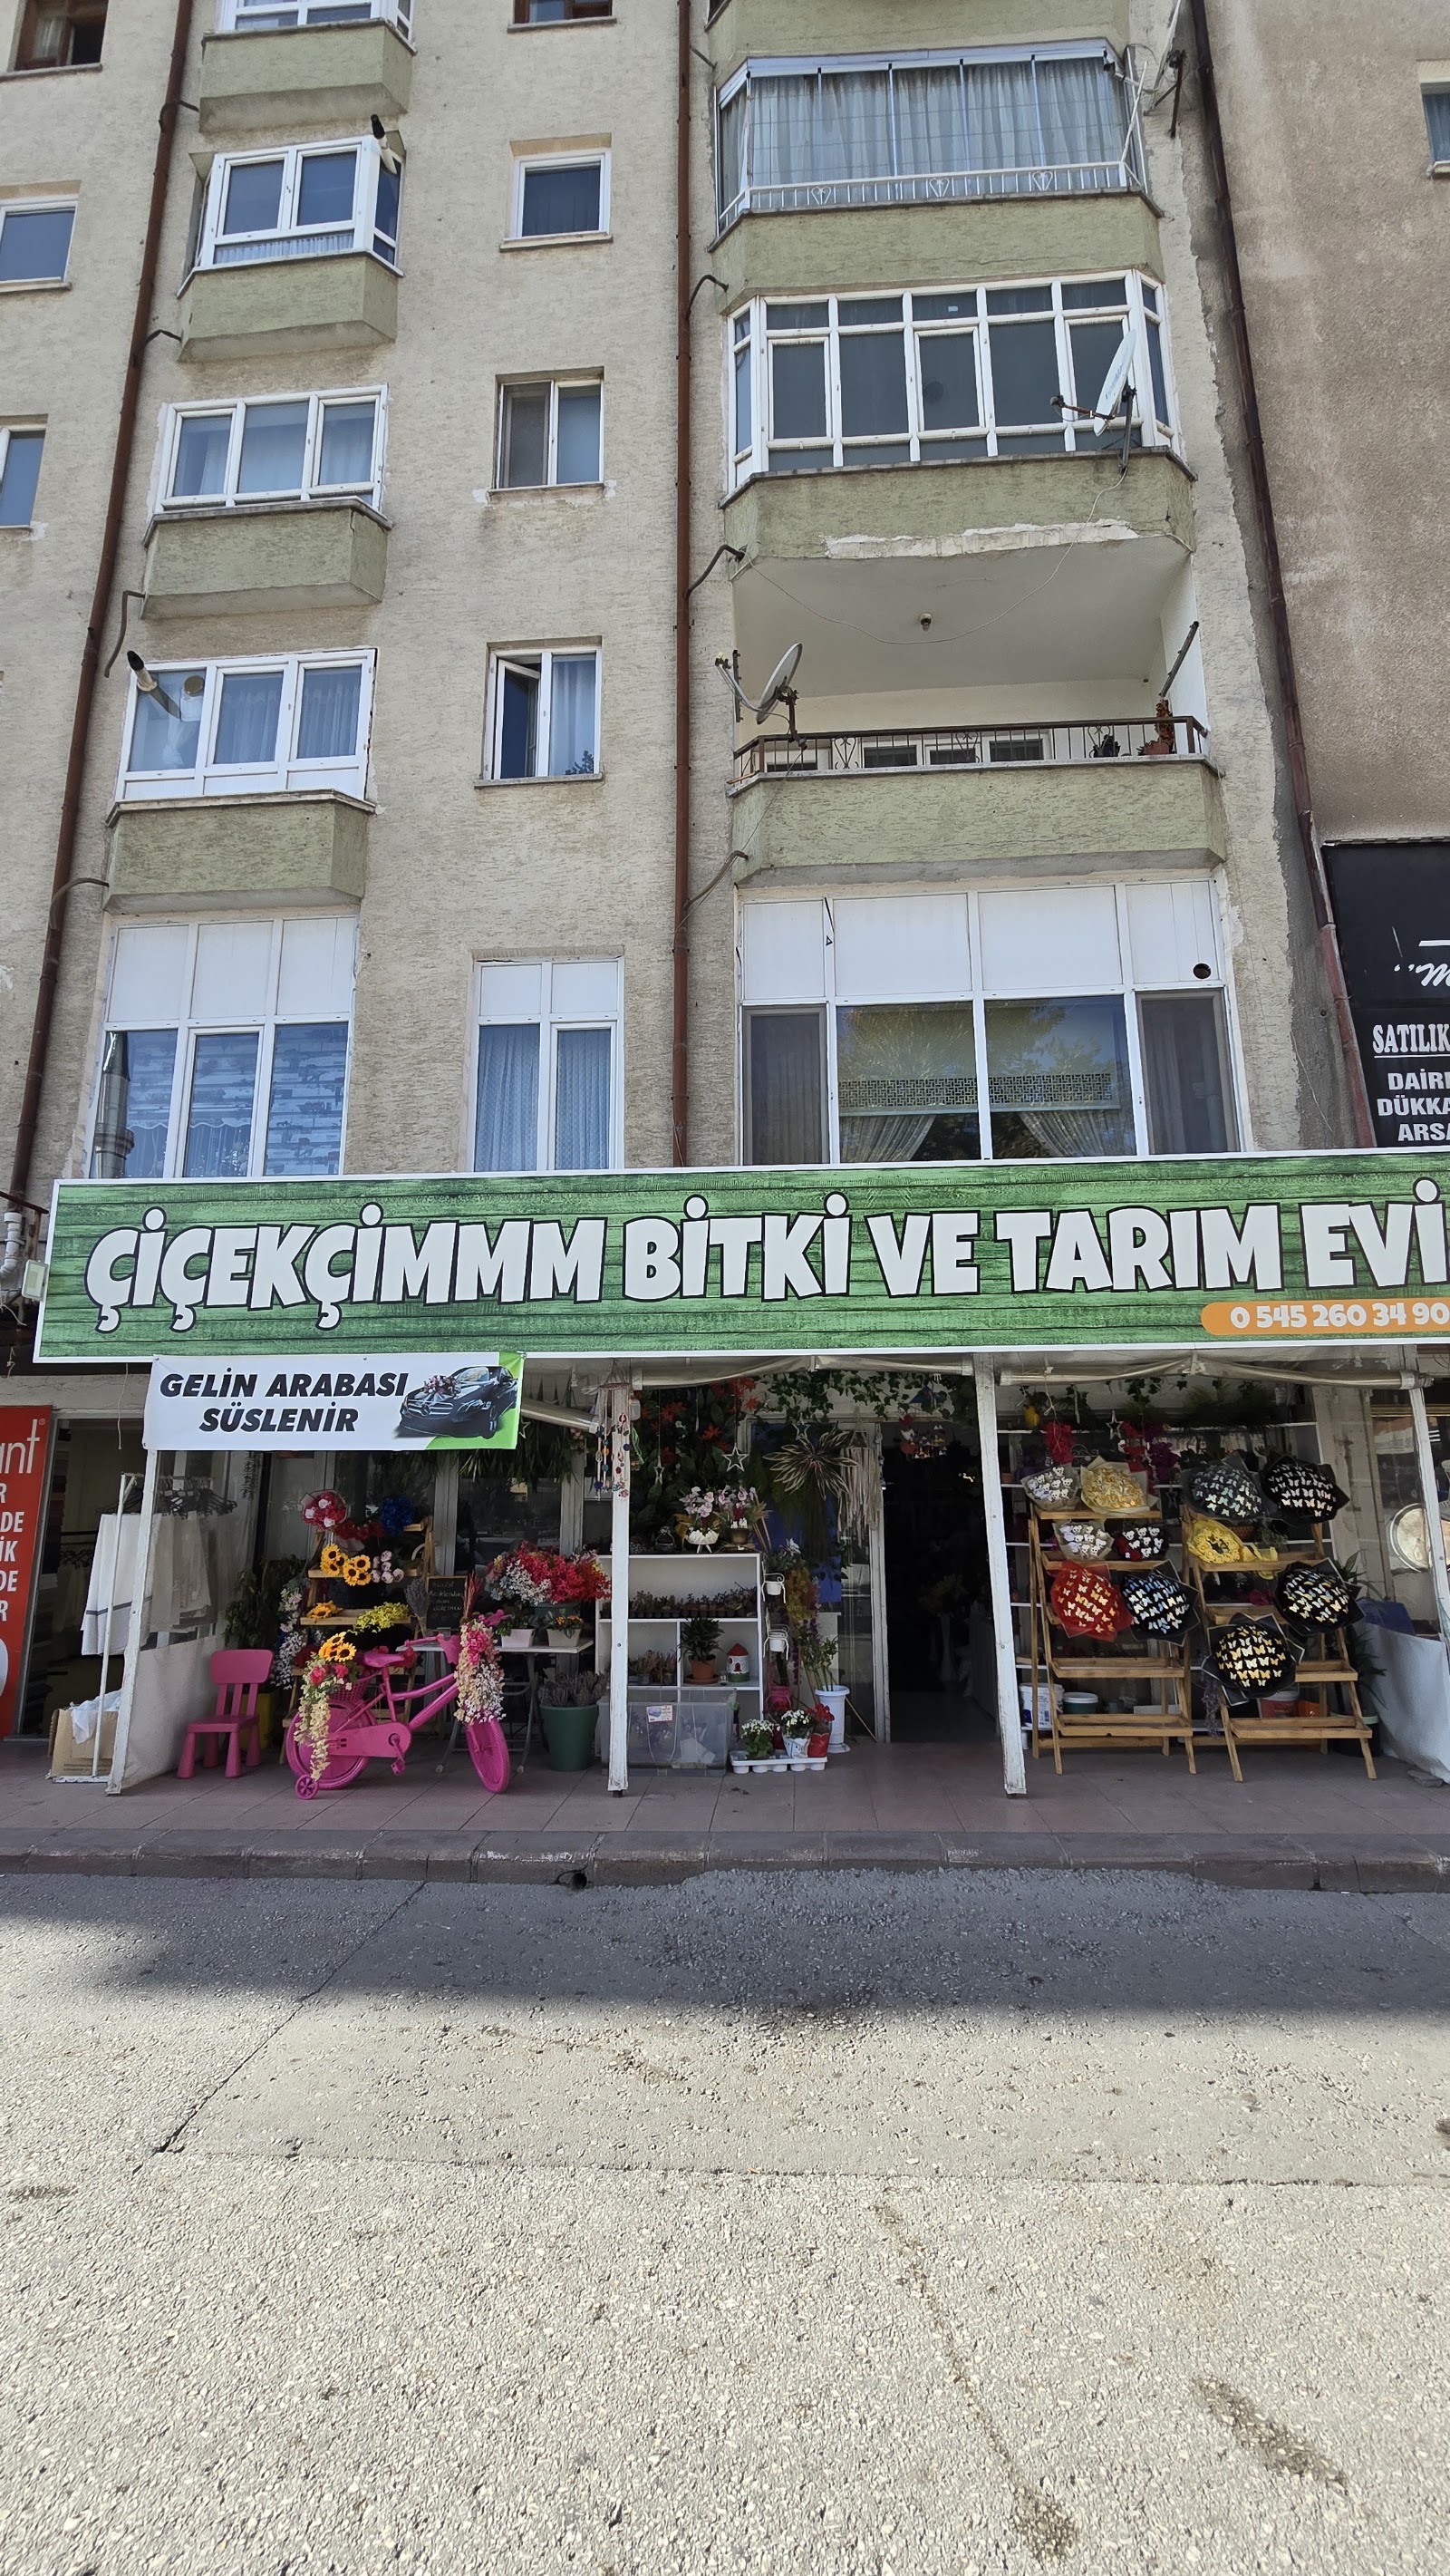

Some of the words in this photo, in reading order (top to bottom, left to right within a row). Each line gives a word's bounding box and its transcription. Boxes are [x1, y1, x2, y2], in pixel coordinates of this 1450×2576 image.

[1372, 1023, 1450, 1054] SATILIK
[1397, 1122, 1450, 1142] ARS
[84, 1202, 607, 1333] ÇİÇEKÇİMMM
[624, 1191, 852, 1303] BİTKİ
[865, 1210, 981, 1298] VE
[994, 1202, 1285, 1294] TARIM
[1298, 1176, 1450, 1291] EVİ
[1230, 1305, 1251, 1329] 0
[1256, 1303, 1308, 1328] 545
[1311, 1303, 1368, 1328] 260
[1371, 1302, 1407, 1326] 34
[1411, 1302, 1450, 1325] 90
[160, 1367, 258, 1399] GELİN
[265, 1371, 410, 1399] ARABASI
[198, 1400, 359, 1433] SÜSLENİR
